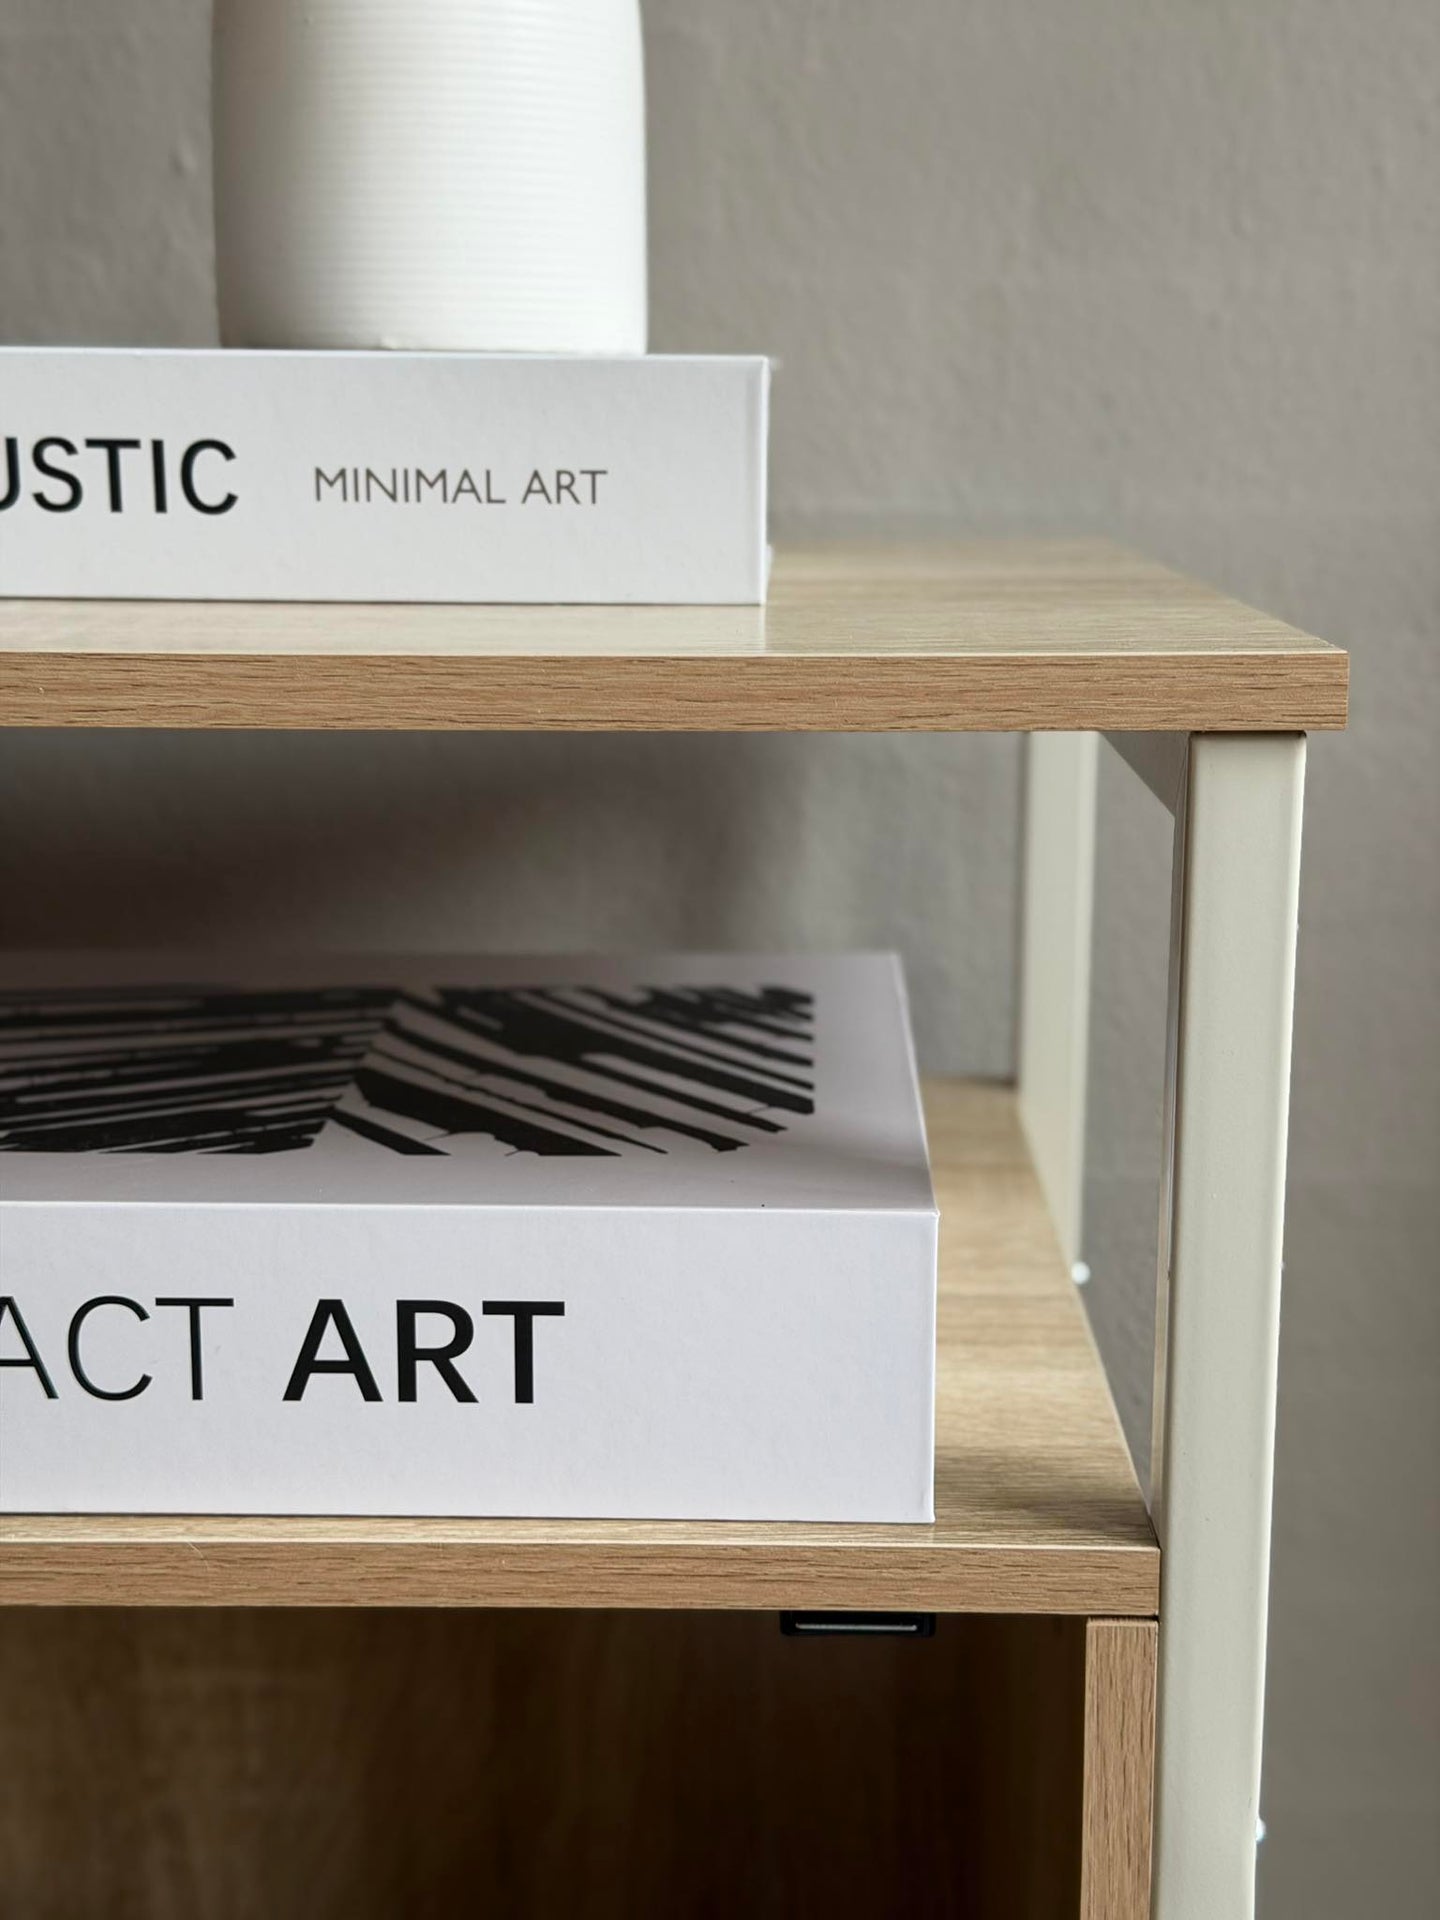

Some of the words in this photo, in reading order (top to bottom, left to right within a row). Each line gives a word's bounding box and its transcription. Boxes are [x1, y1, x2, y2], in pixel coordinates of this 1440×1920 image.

[315, 466, 506, 504] MINIMAL
[522, 470, 608, 505] ART
[282, 1298, 566, 1405] ART
